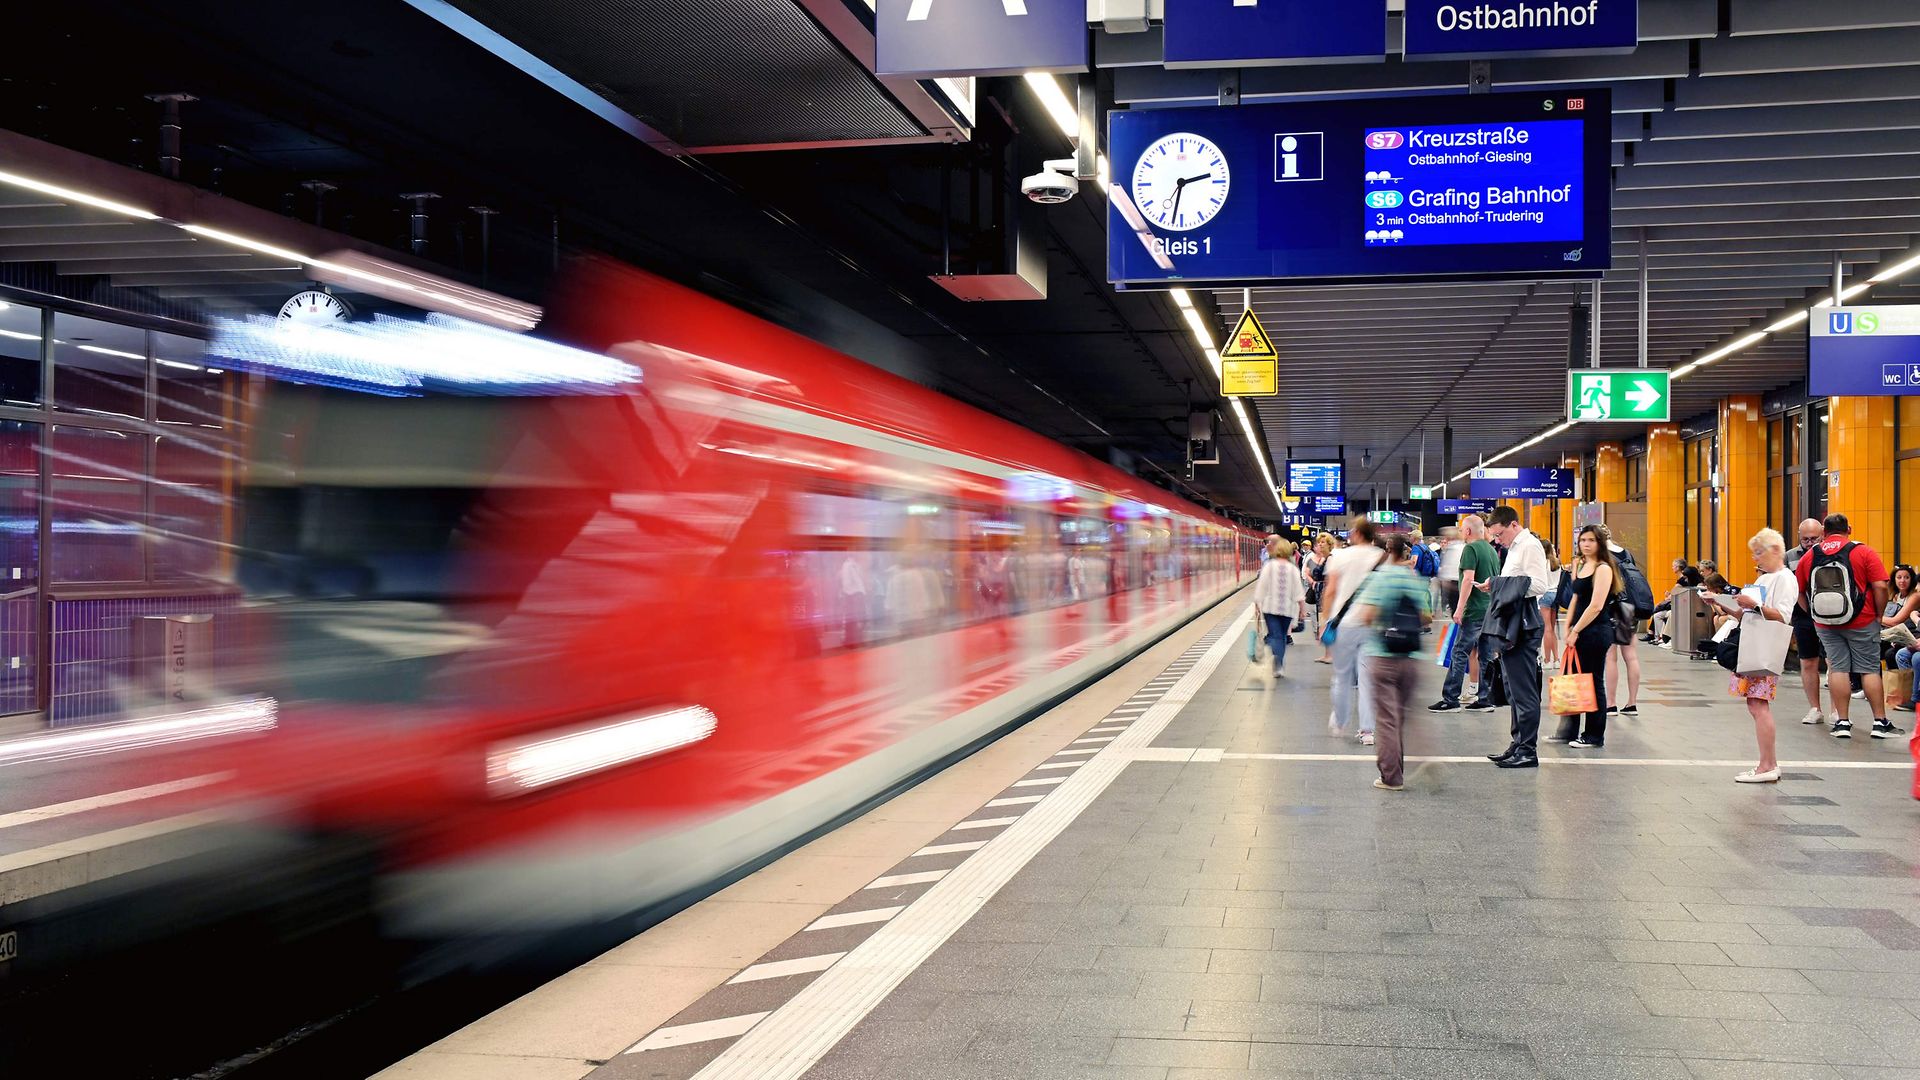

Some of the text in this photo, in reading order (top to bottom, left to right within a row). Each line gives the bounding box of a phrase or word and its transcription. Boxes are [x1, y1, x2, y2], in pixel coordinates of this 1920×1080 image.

[1436, 0, 1598, 31] Ostbahnhof
[1568, 99, 1583, 110] DB
[1372, 126, 1529, 148] S7 Kreuzstraße
[1408, 150, 1532, 166] Ostbahnhof-Giesing
[1372, 184, 1571, 208] S6 Grafing Bahnhof
[1376, 213, 1404, 226] 3 min
[1408, 210, 1544, 225] Ostbahnhof-Trudering
[1150, 236, 1212, 256] Gleis 1
[1832, 313, 1849, 333] U
[1858, 313, 1877, 333] S
[1884, 374, 1902, 384] WC
[1550, 468, 1558, 480] 2
[172, 644, 185, 701] Abfall
